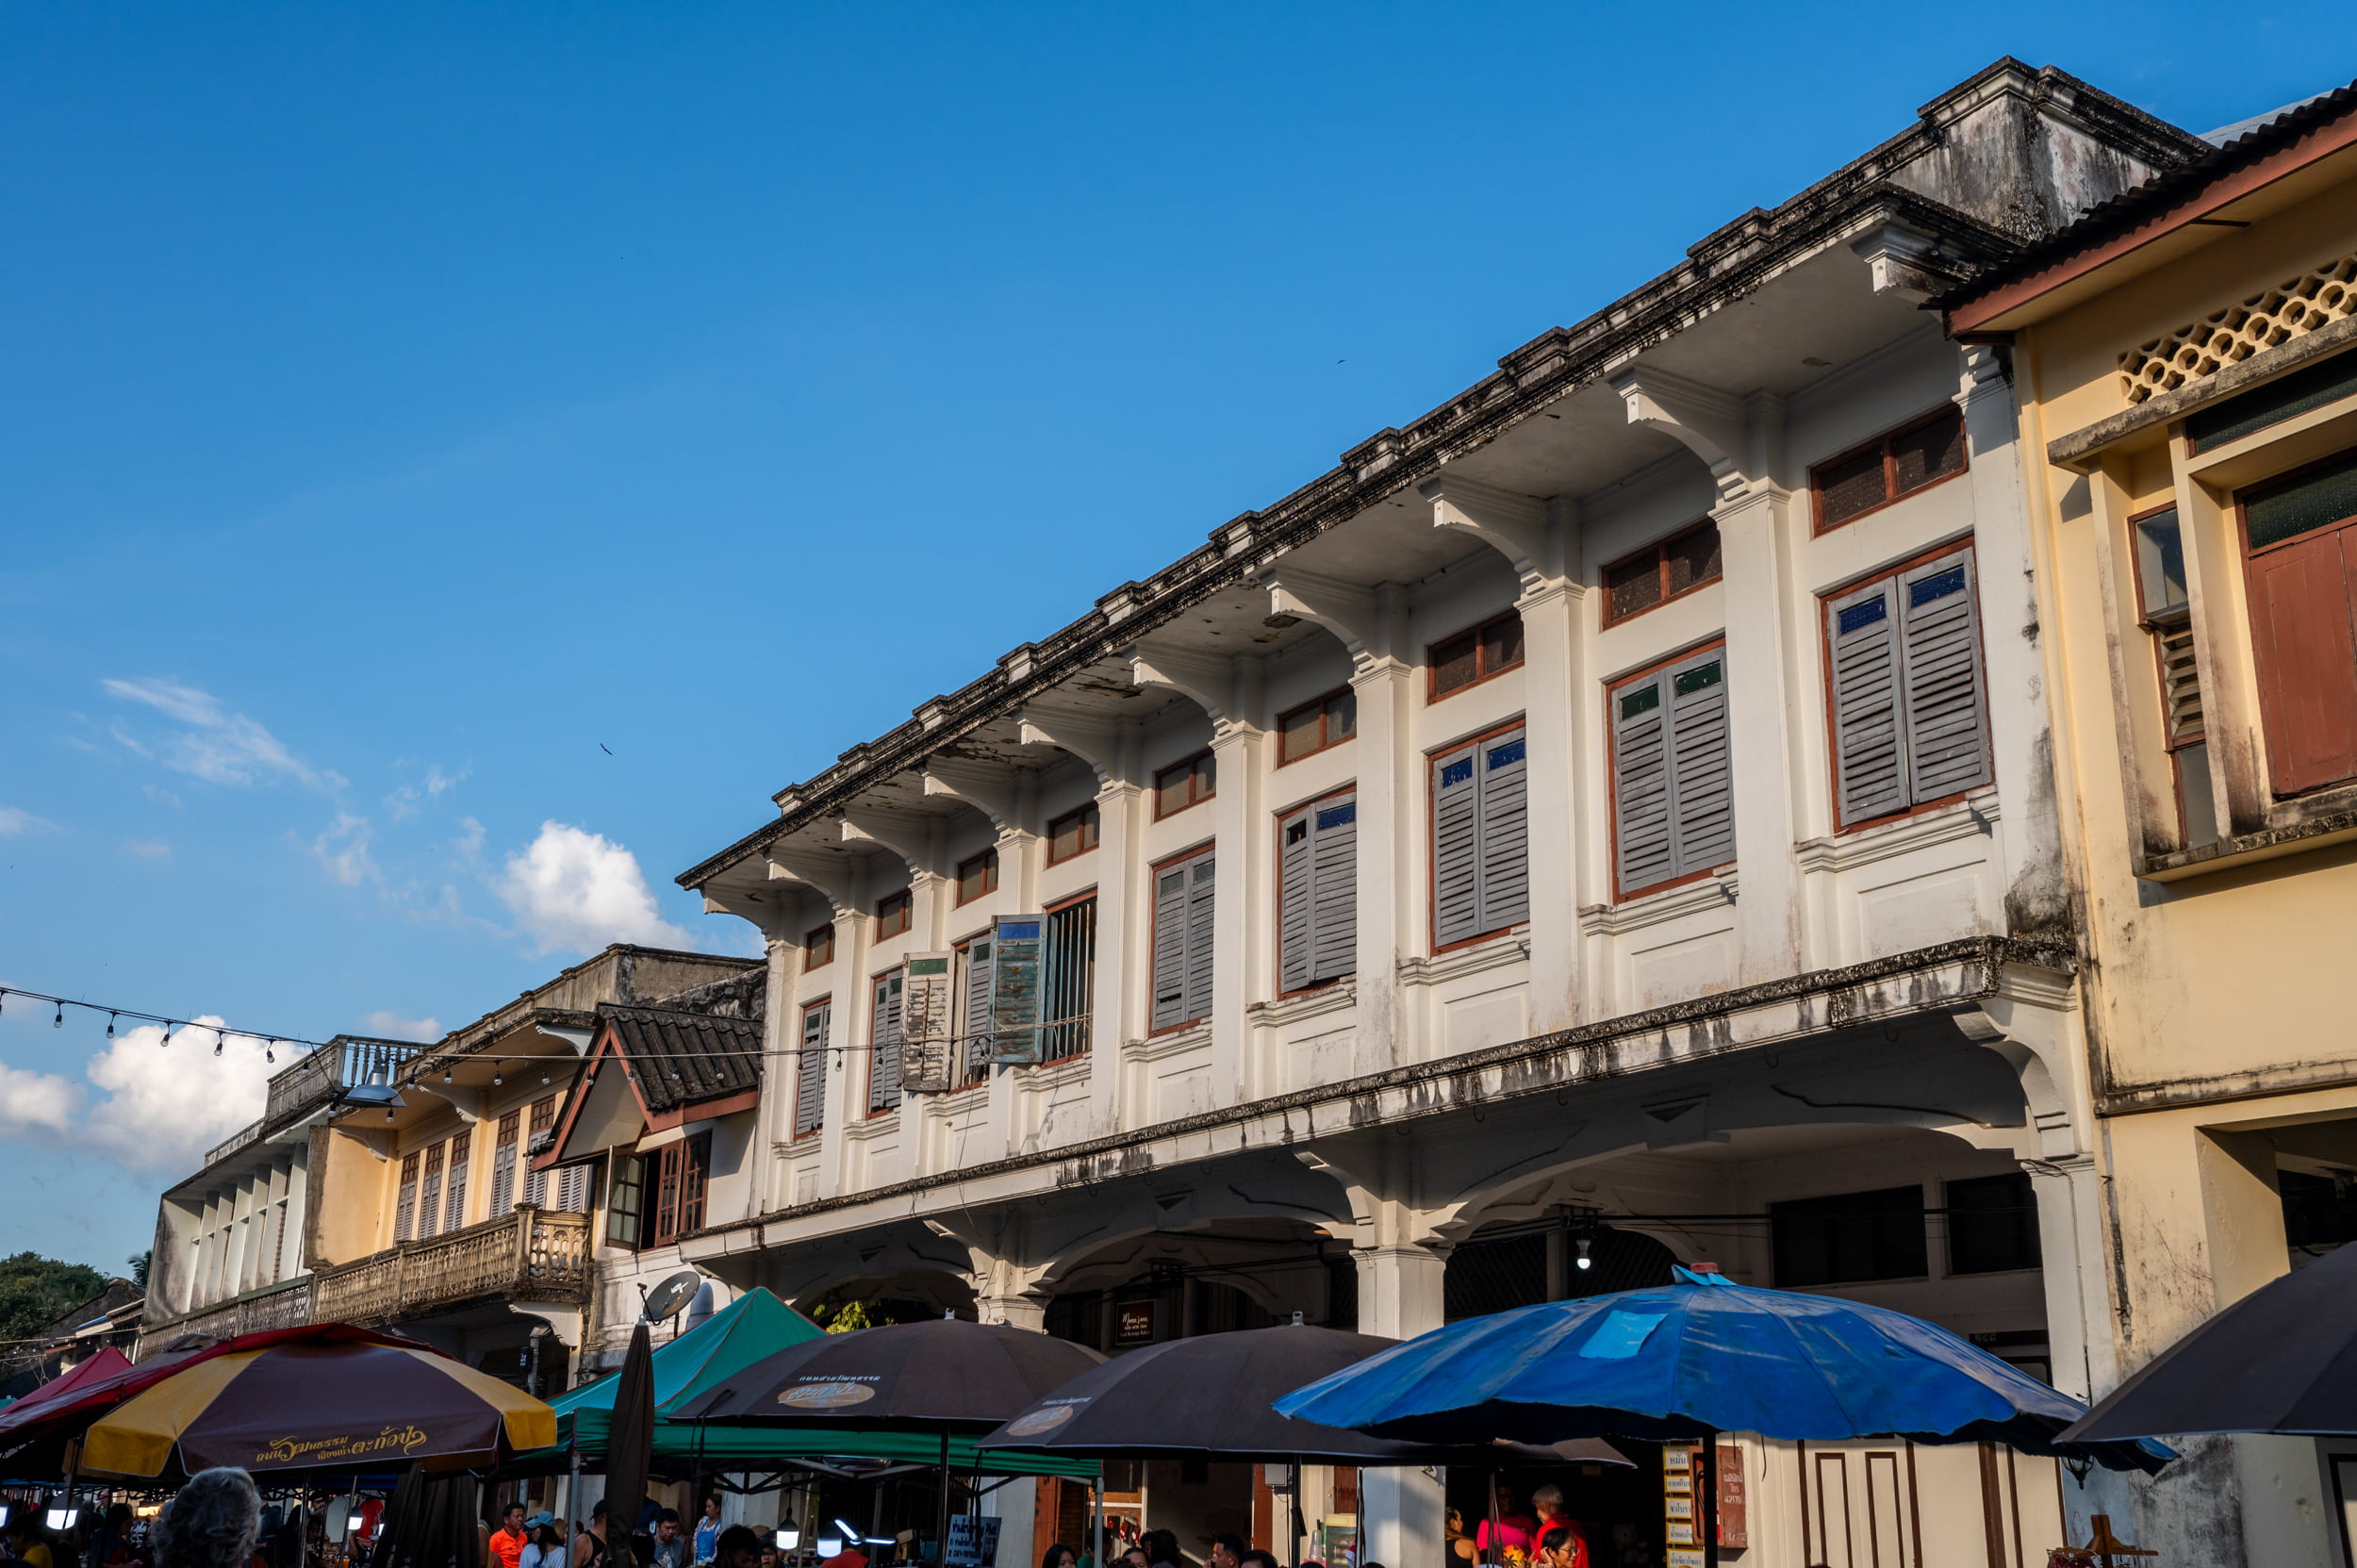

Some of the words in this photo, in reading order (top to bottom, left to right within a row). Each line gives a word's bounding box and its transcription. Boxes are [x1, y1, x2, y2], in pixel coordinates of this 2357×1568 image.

[255, 1435, 349, 1462] ถนนวัฒนธรรม
[352, 1425, 427, 1456] ตะกั่วป่า
